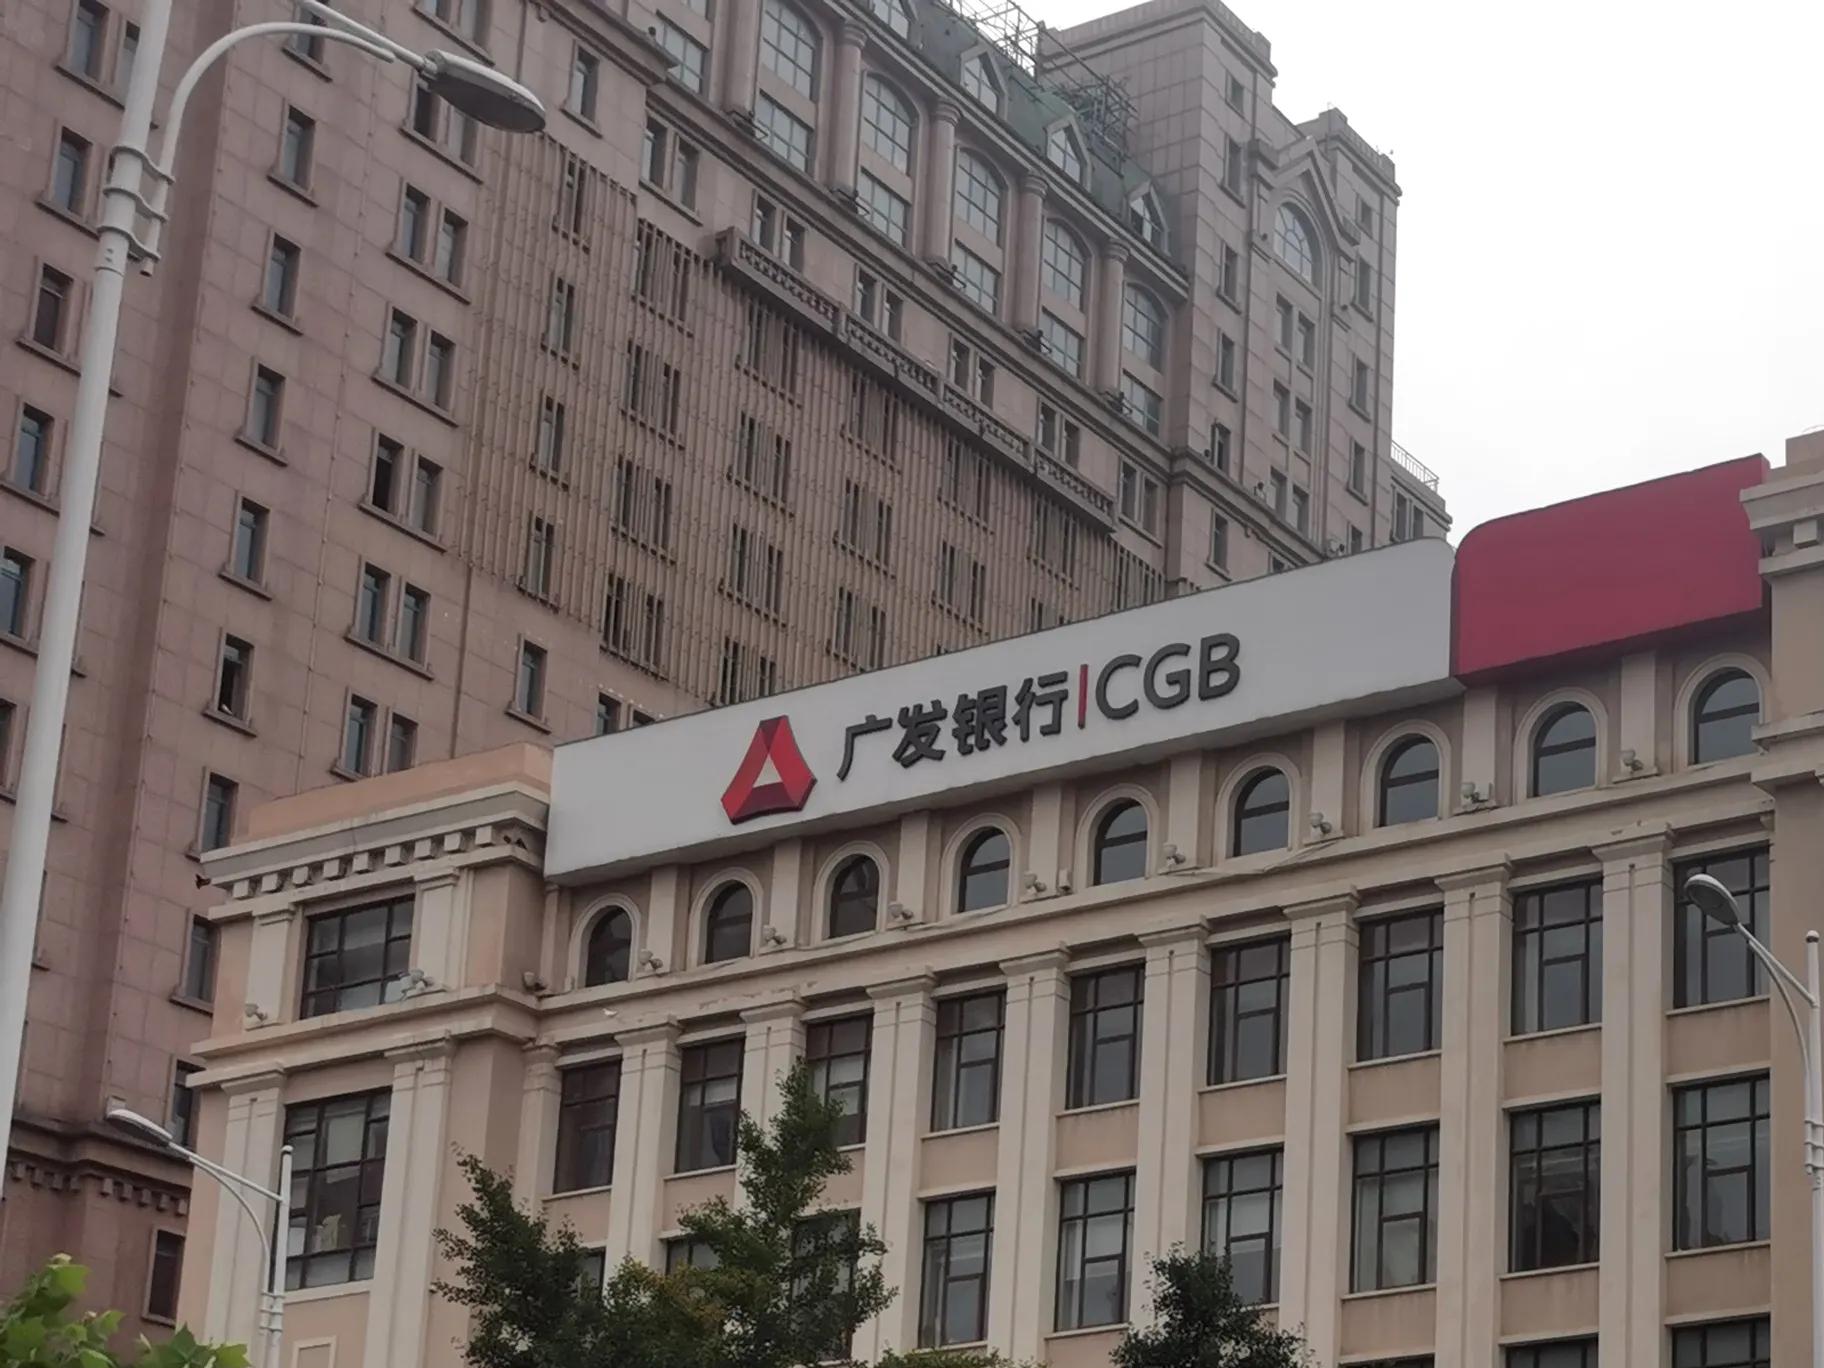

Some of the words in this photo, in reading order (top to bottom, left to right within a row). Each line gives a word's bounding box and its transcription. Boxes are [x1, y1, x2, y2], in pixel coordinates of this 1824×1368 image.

[836, 671, 1069, 782] 广发银行
[1095, 633, 1241, 720] CGB
